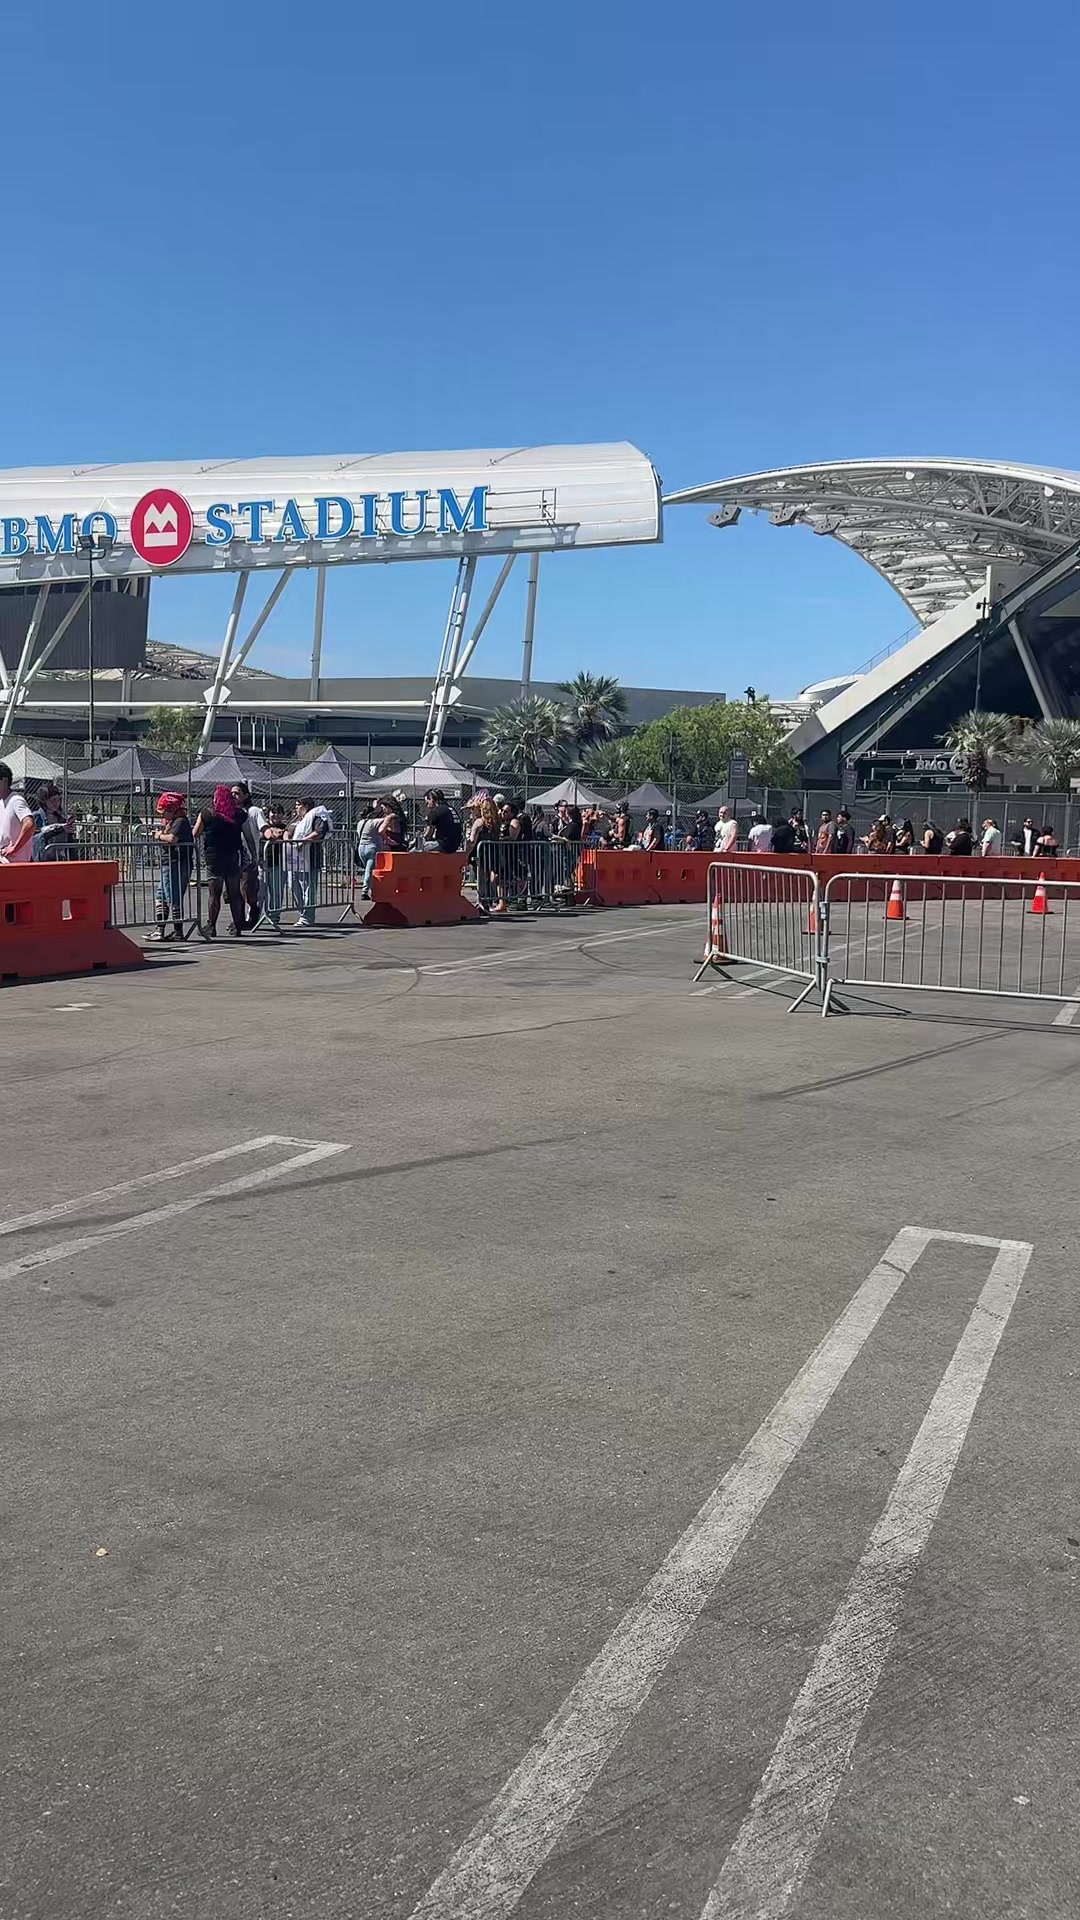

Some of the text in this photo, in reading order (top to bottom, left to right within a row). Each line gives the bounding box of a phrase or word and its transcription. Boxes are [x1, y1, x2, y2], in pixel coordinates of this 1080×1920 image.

[0, 485, 489, 556] BMO STADIUM
[915, 759, 948, 771] BMO
